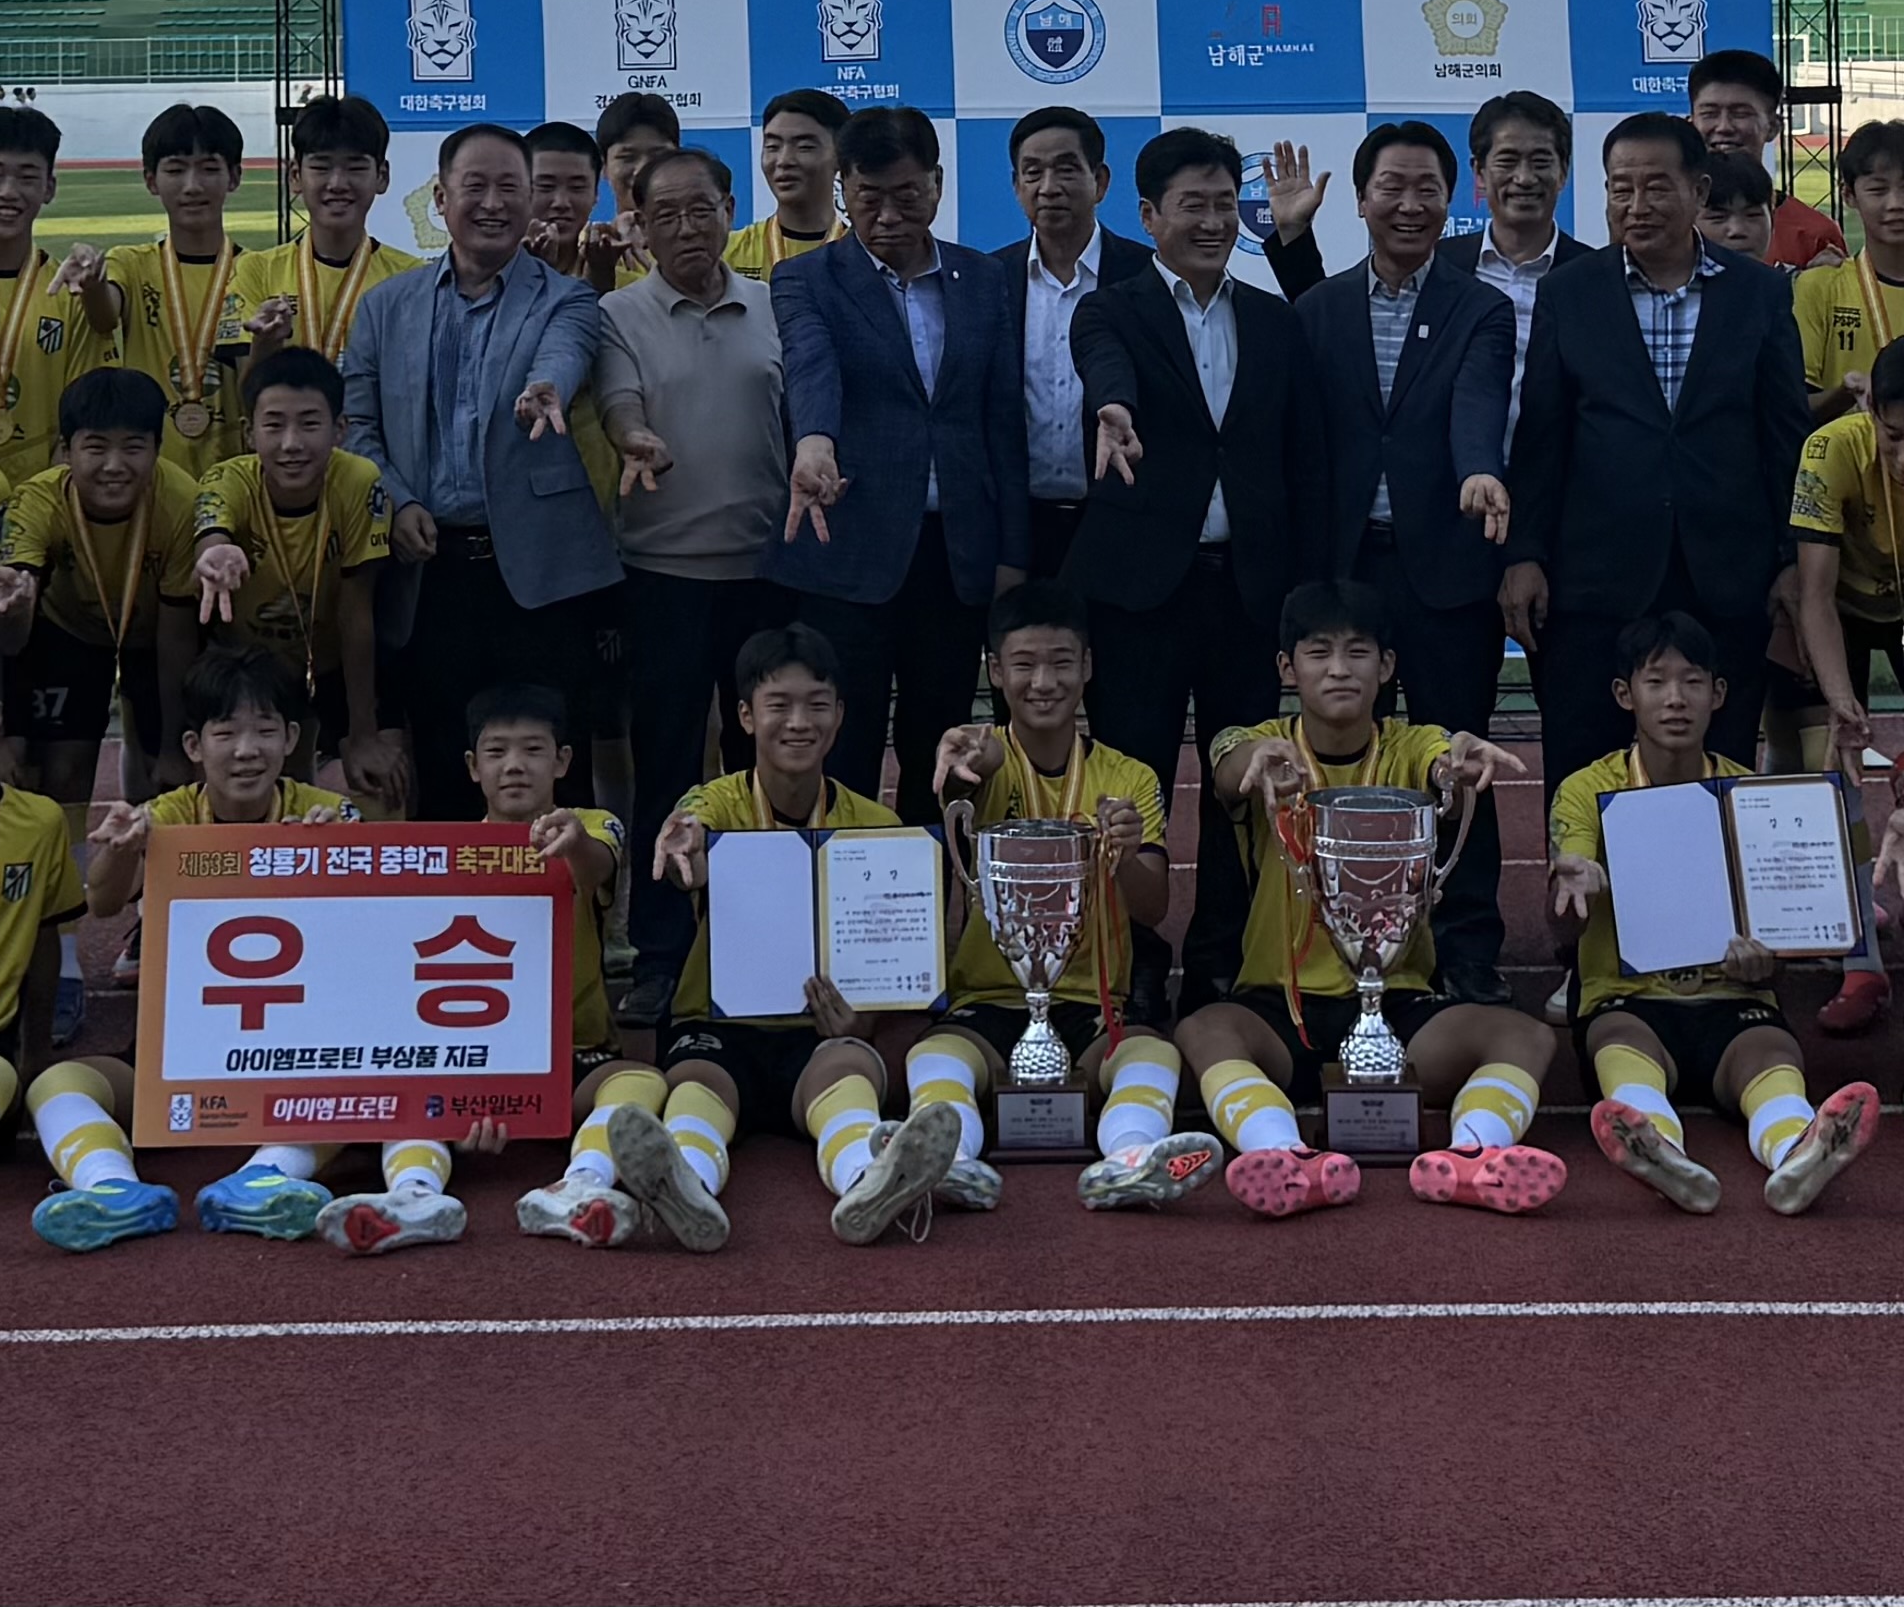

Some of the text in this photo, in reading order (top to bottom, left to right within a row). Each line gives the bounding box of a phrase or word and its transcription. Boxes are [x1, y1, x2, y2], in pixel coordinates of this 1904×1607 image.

[1451, 11, 1479, 26] 의회
[1208, 44, 1264, 67] 남해군
[837, 65, 866, 81] NFA
[1434, 63, 1502, 78] 남해군의회
[628, 75, 668, 90] GNFA
[1632, 76, 1690, 93] 대한축구
[400, 94, 486, 112] 대한축구협회
[1838, 330, 1854, 351] 11
[32, 687, 69, 720] 37
[178, 845, 546, 878] 제63회 청룡기 전국 중학교 축구대회
[202, 914, 517, 1031] 우 승
[225, 1044, 489, 1073] 아이엠프로틴 부상품 지급
[199, 1095, 229, 1111] KFA
[273, 1095, 399, 1123] 아이엠프로틴
